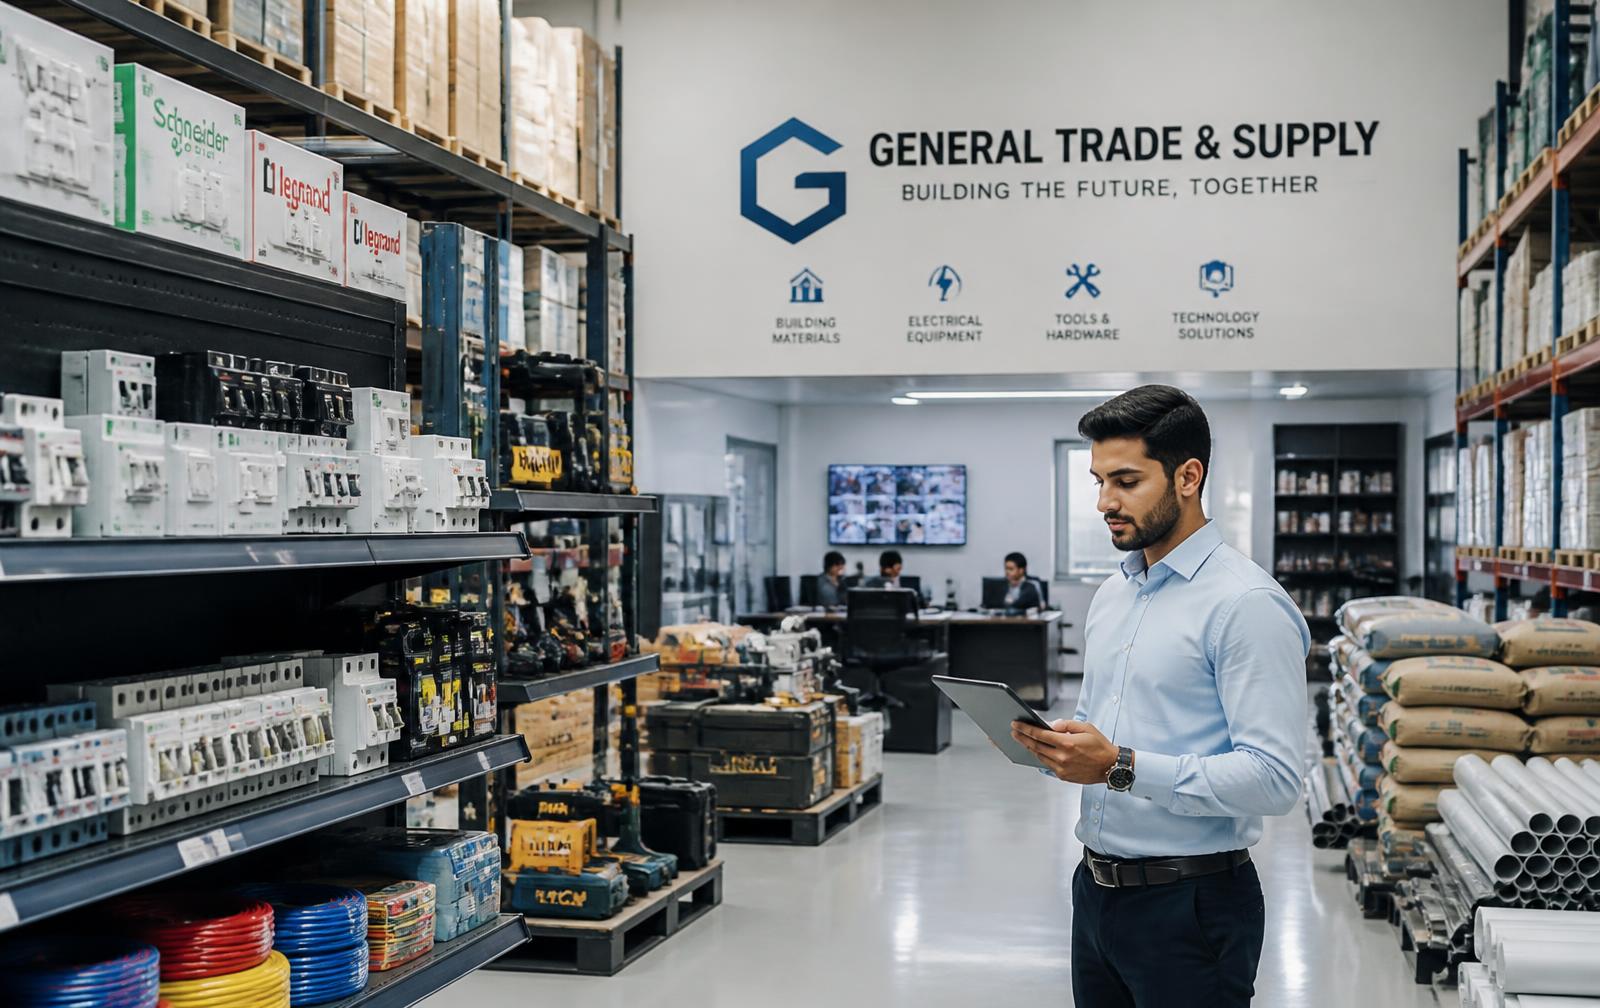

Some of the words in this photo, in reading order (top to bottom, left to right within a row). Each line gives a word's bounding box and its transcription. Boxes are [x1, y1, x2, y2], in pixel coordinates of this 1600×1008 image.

[869, 129, 1043, 167] GENERAL
[1055, 126, 1183, 163] TRADE
[1194, 124, 1221, 160] &
[1233, 120, 1380, 160] SUPPLY
[902, 182, 1010, 203] BUILDING
[1020, 181, 1066, 200] THE
[1077, 178, 1178, 200] FUTURE,
[1189, 175, 1319, 197] TOGETHER
[776, 317, 836, 329] BUILDING
[908, 315, 982, 327] ELECTRICAL
[1055, 313, 1097, 326] TOOLS
[1101, 313, 1110, 326] &
[1172, 311, 1260, 325] TECHNOLOGY
[772, 332, 840, 344] MATERIALS
[907, 330, 983, 343] EQUIPMENT
[1046, 329, 1120, 341] HARDWARE
[1178, 326, 1255, 340] SOLUTIONS
